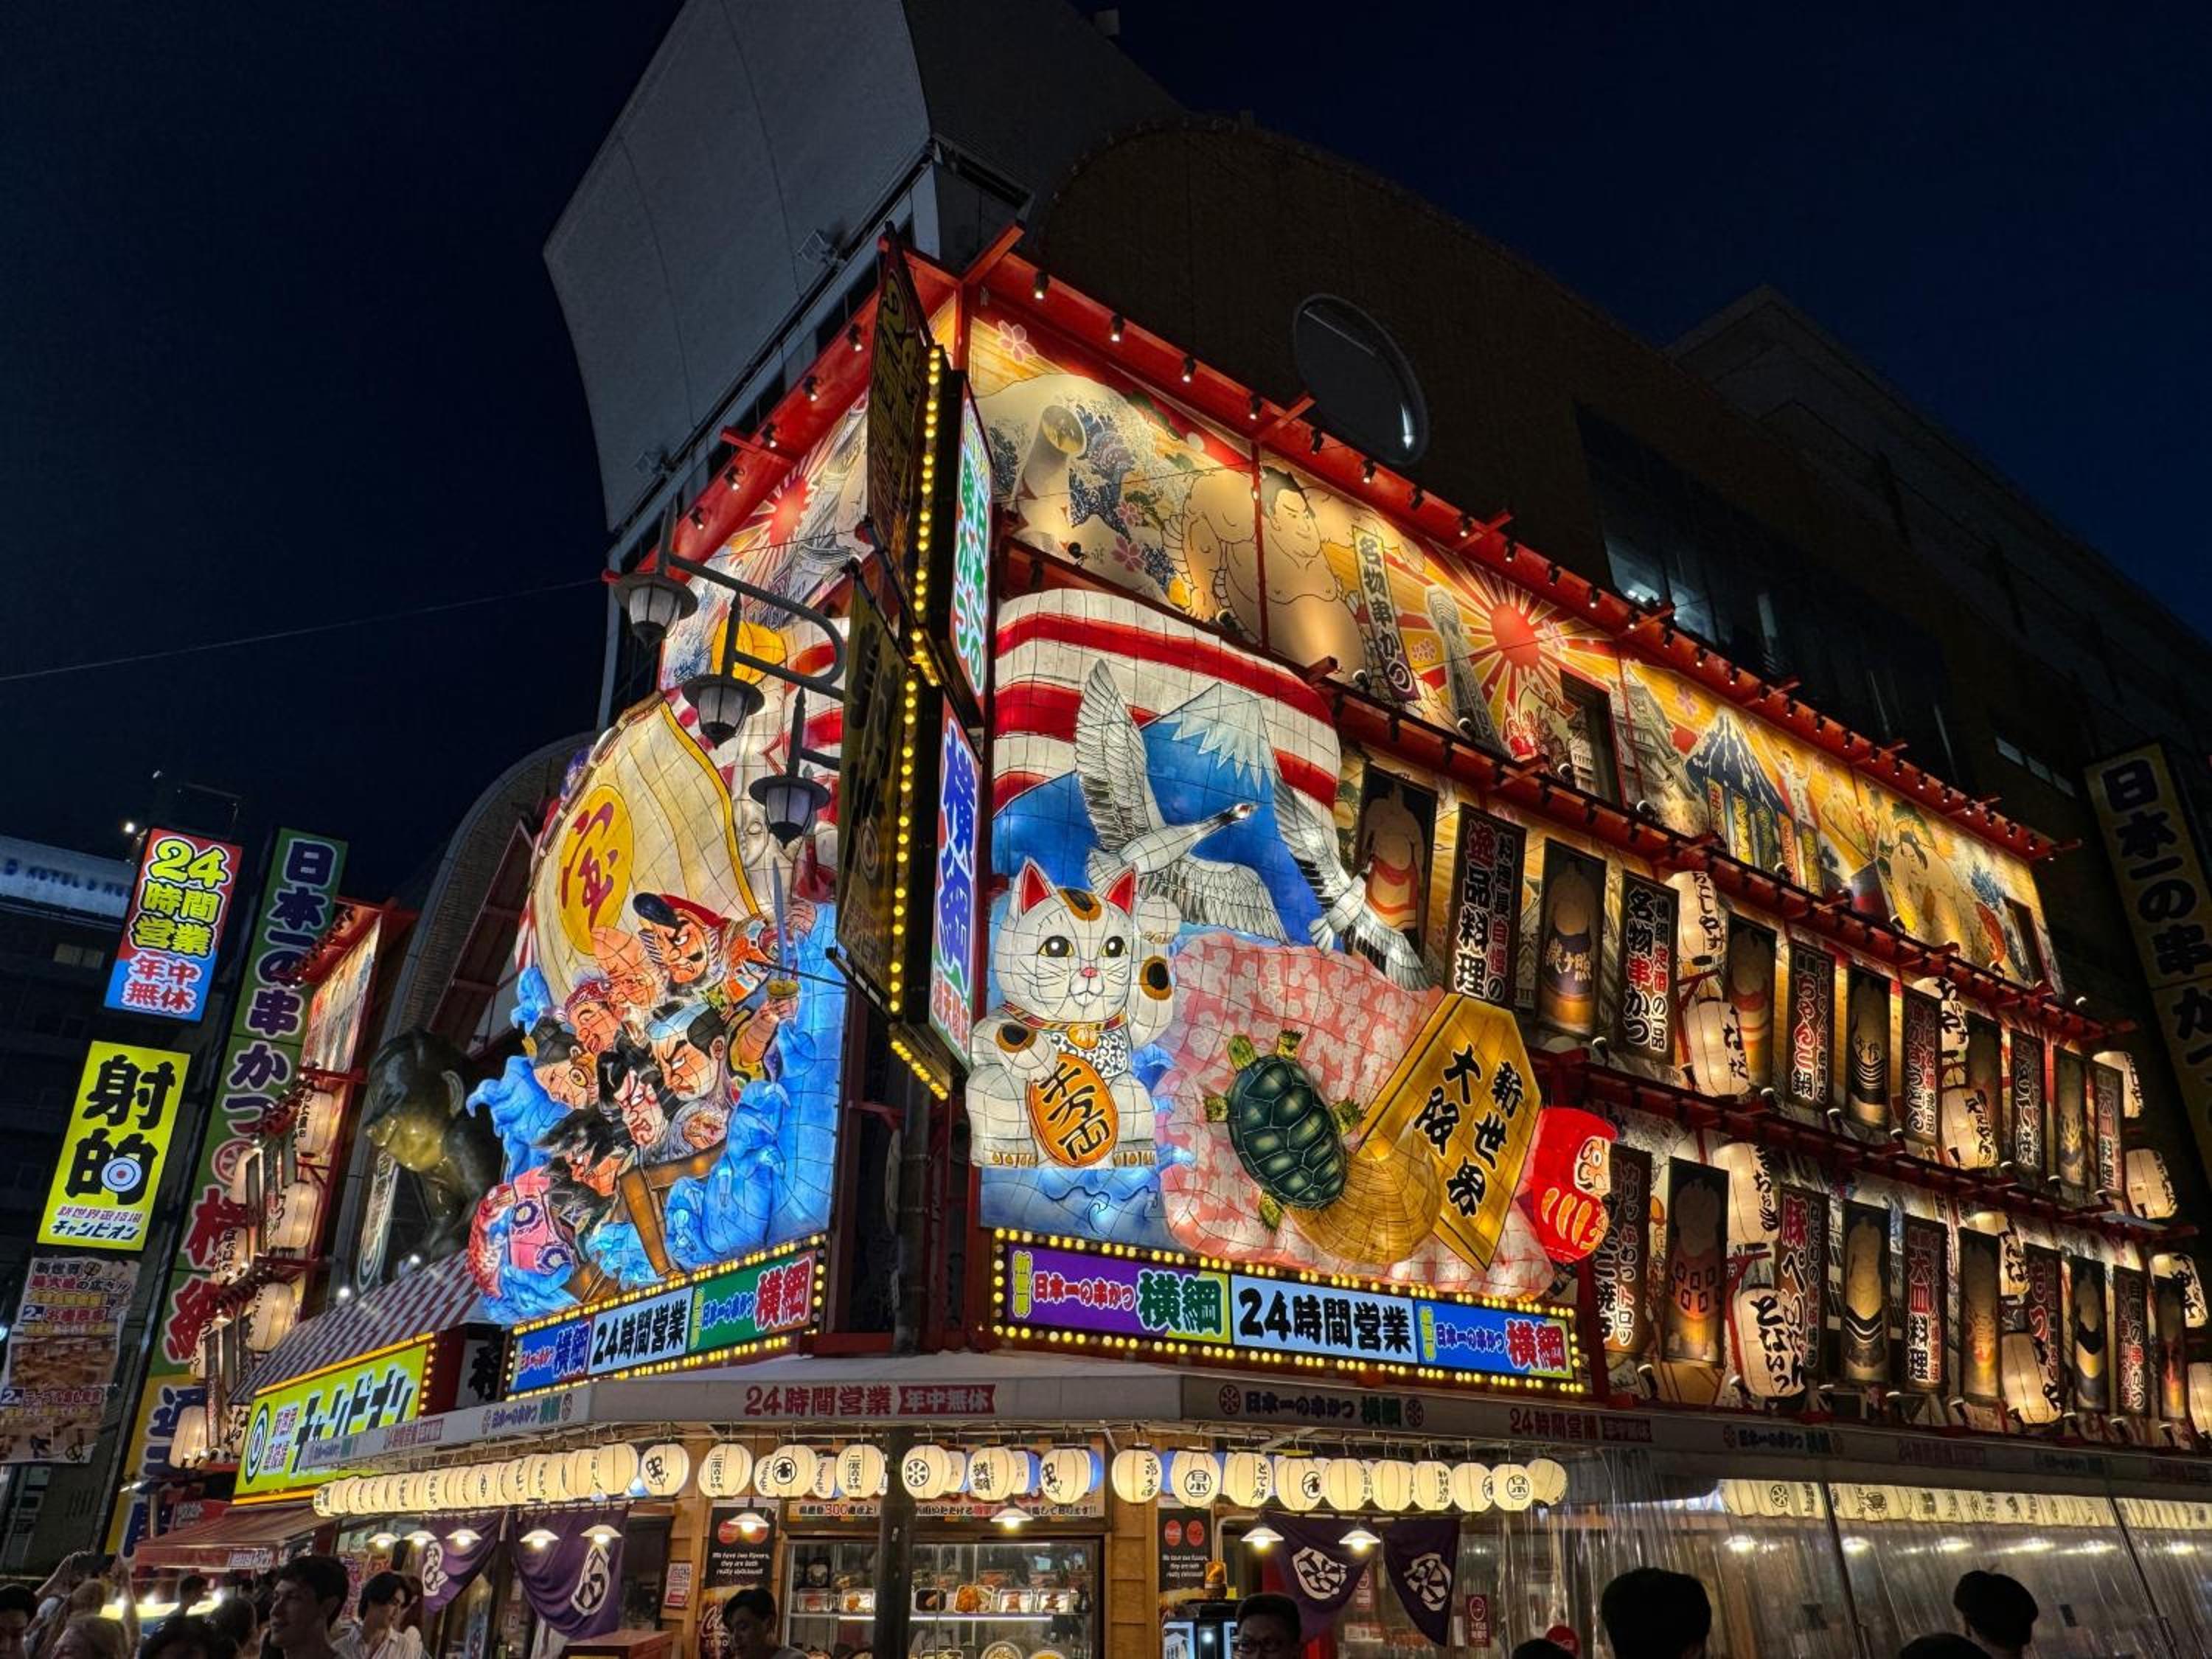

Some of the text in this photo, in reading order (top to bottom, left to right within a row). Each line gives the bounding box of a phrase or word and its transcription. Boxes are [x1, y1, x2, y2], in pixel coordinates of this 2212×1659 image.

[1357, 536, 1416, 692] 名物串かつ
[150, 839, 229, 888] 24
[938, 718, 977, 998] 横綱
[141, 881, 223, 923] 時間
[131, 912, 214, 957] 営業
[128, 956, 202, 987] 年中
[1625, 887, 1655, 1046] 名物串かつ
[123, 981, 198, 1015] 無休
[1414, 1042, 1484, 1156] 大阪
[65, 1055, 176, 1207] 射的
[1446, 1061, 1526, 1217] 新世界
[52, 1219, 140, 1241] チャンピオン
[755, 1259, 811, 1330] 横綱
[1033, 1273, 1135, 1310] 日本一の串かつ
[1137, 1270, 1223, 1334] 横綱
[593, 1298, 689, 1366] 24時間営業
[1239, 1289, 1413, 1354] 24時間営業
[1436, 1325, 1505, 1352] 日本一の串かつ
[1505, 1319, 1567, 1372] 横綱
[554, 1324, 591, 1377] 横綱
[744, 1386, 991, 1416] 24時間営業 年中無休
[1245, 1390, 1355, 1420] 日本一の串かつ
[1509, 1408, 1597, 1439] 24時間営業
